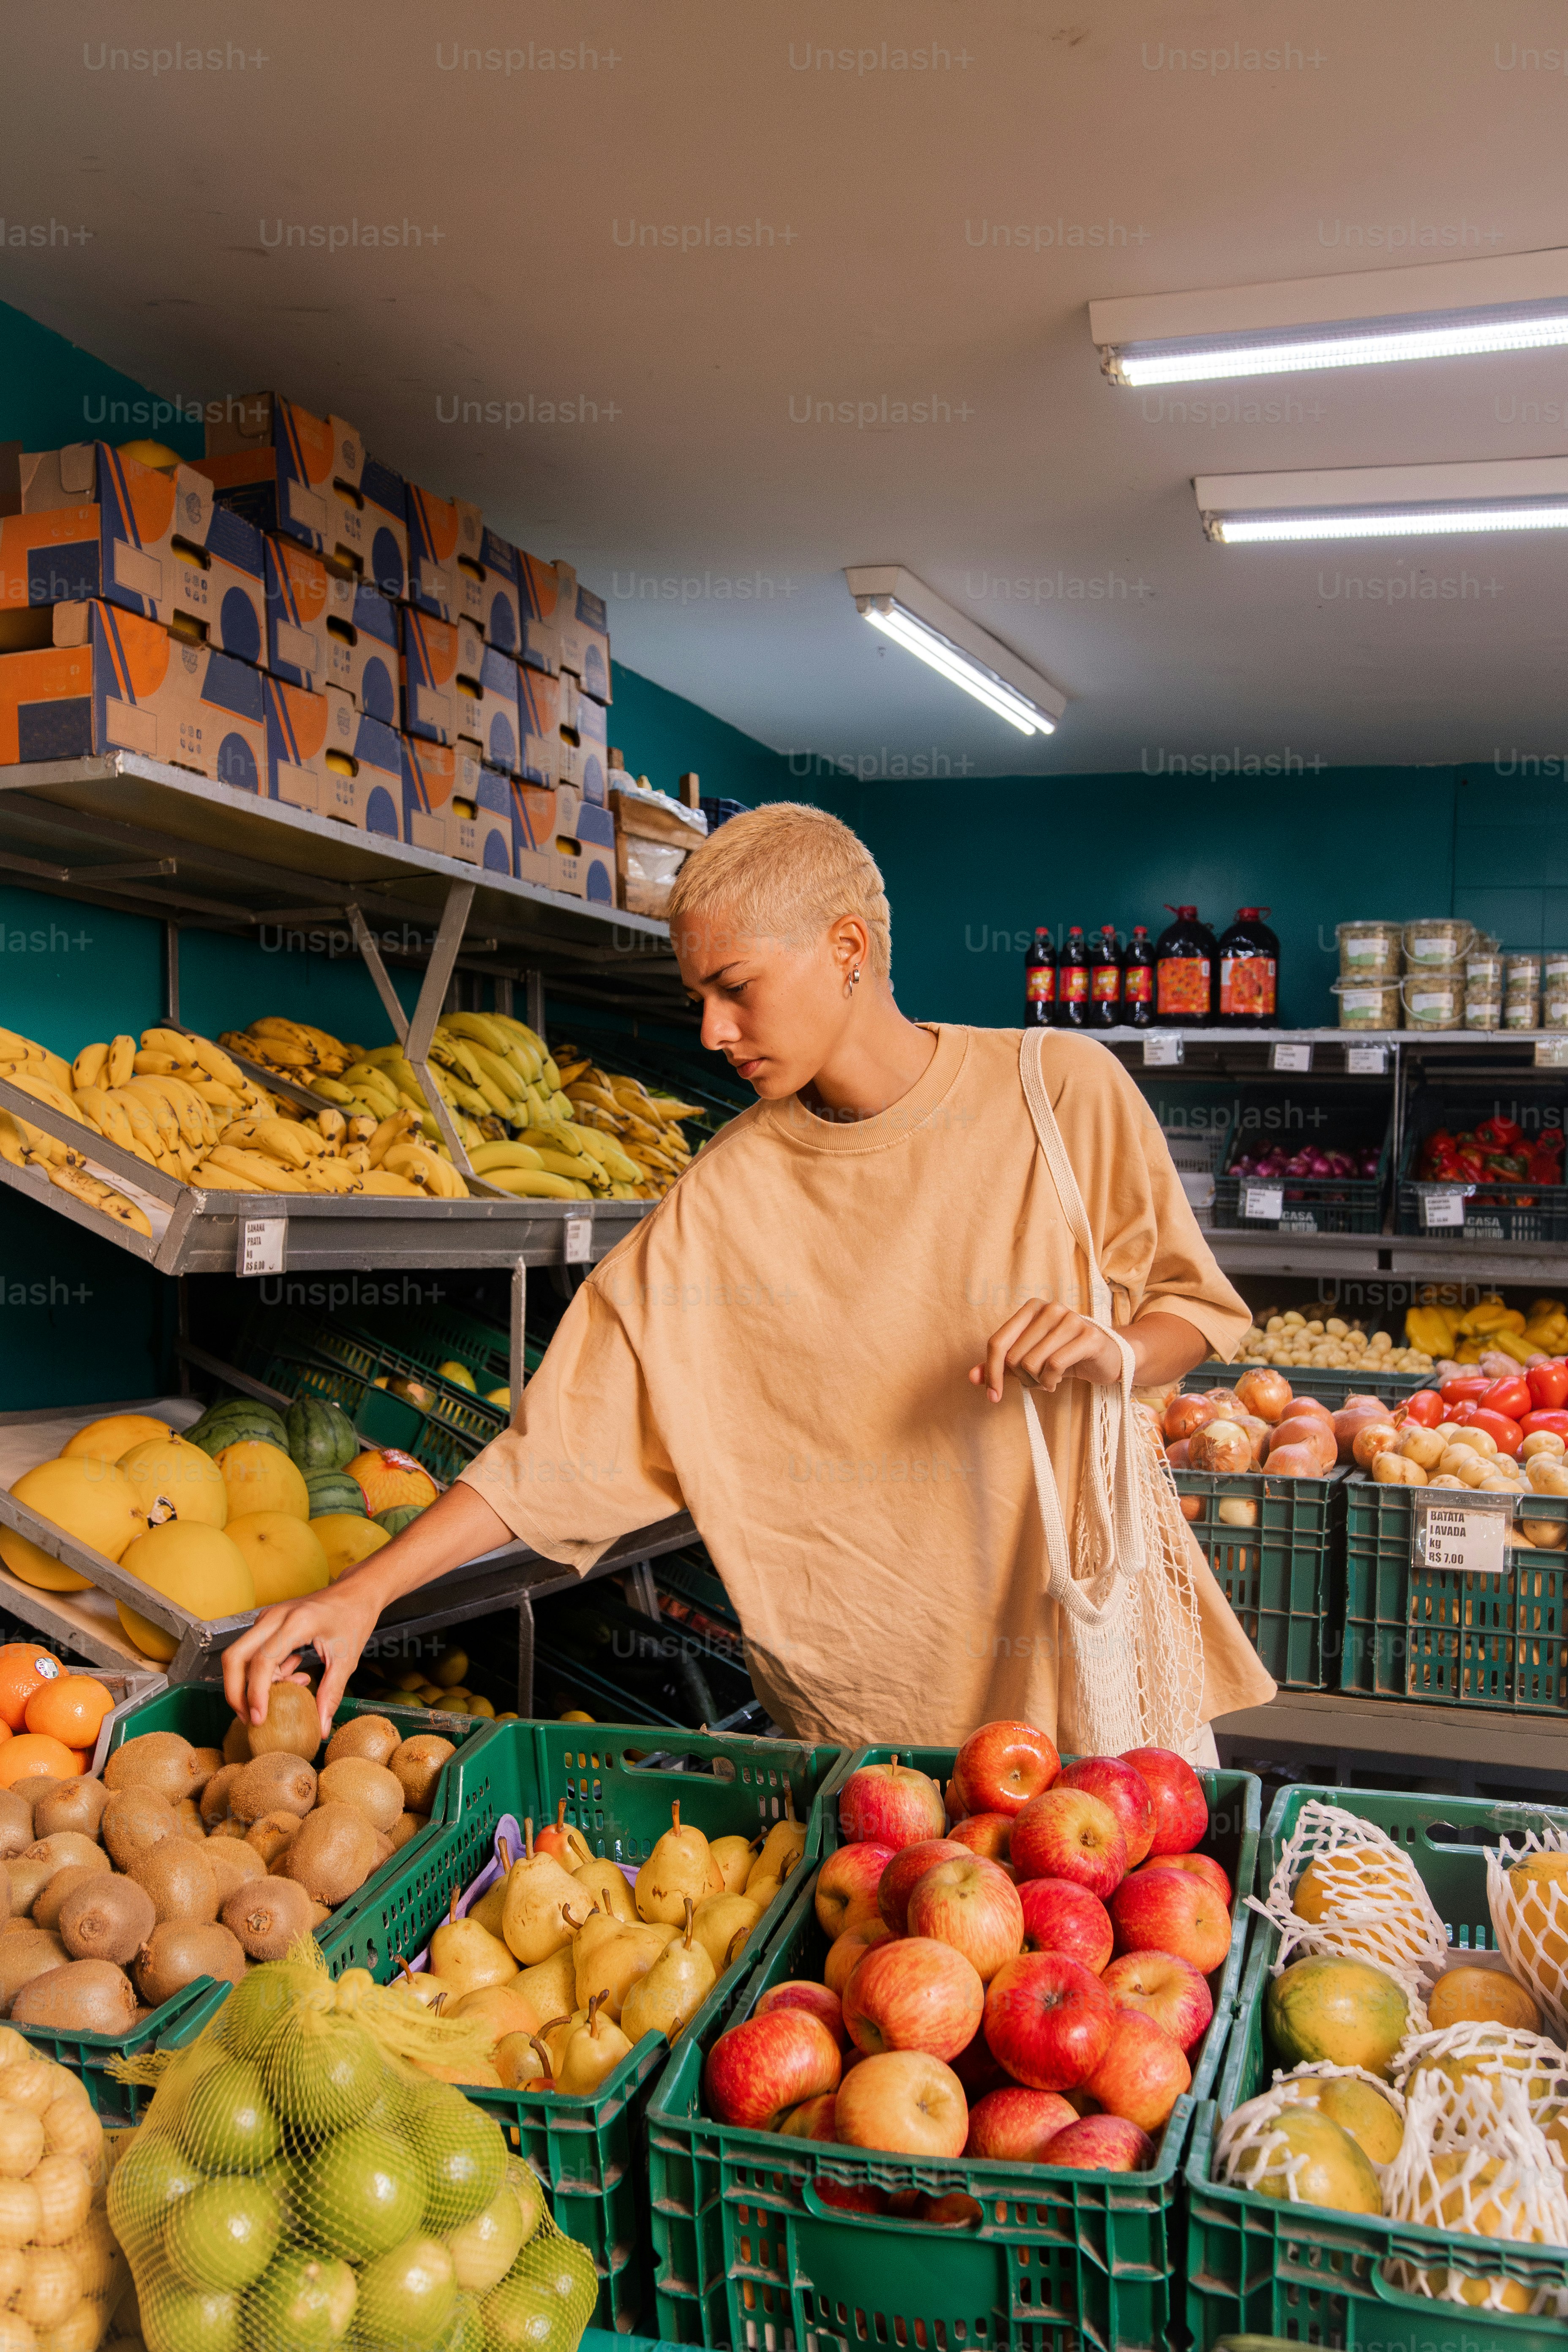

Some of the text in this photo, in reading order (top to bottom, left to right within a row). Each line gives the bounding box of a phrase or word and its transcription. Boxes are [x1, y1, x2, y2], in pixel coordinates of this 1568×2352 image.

[1282, 1211, 1314, 1221] CASA
[1466, 1217, 1500, 1227] CASA
[247, 1236, 261, 1246] PRATA
[1430, 1511, 1465, 1522] BATATA
[1430, 1525, 1466, 1537] LAVADA
[1429, 1538, 1441, 1549] kg
[1429, 1552, 1464, 1564] R$ 7,00
